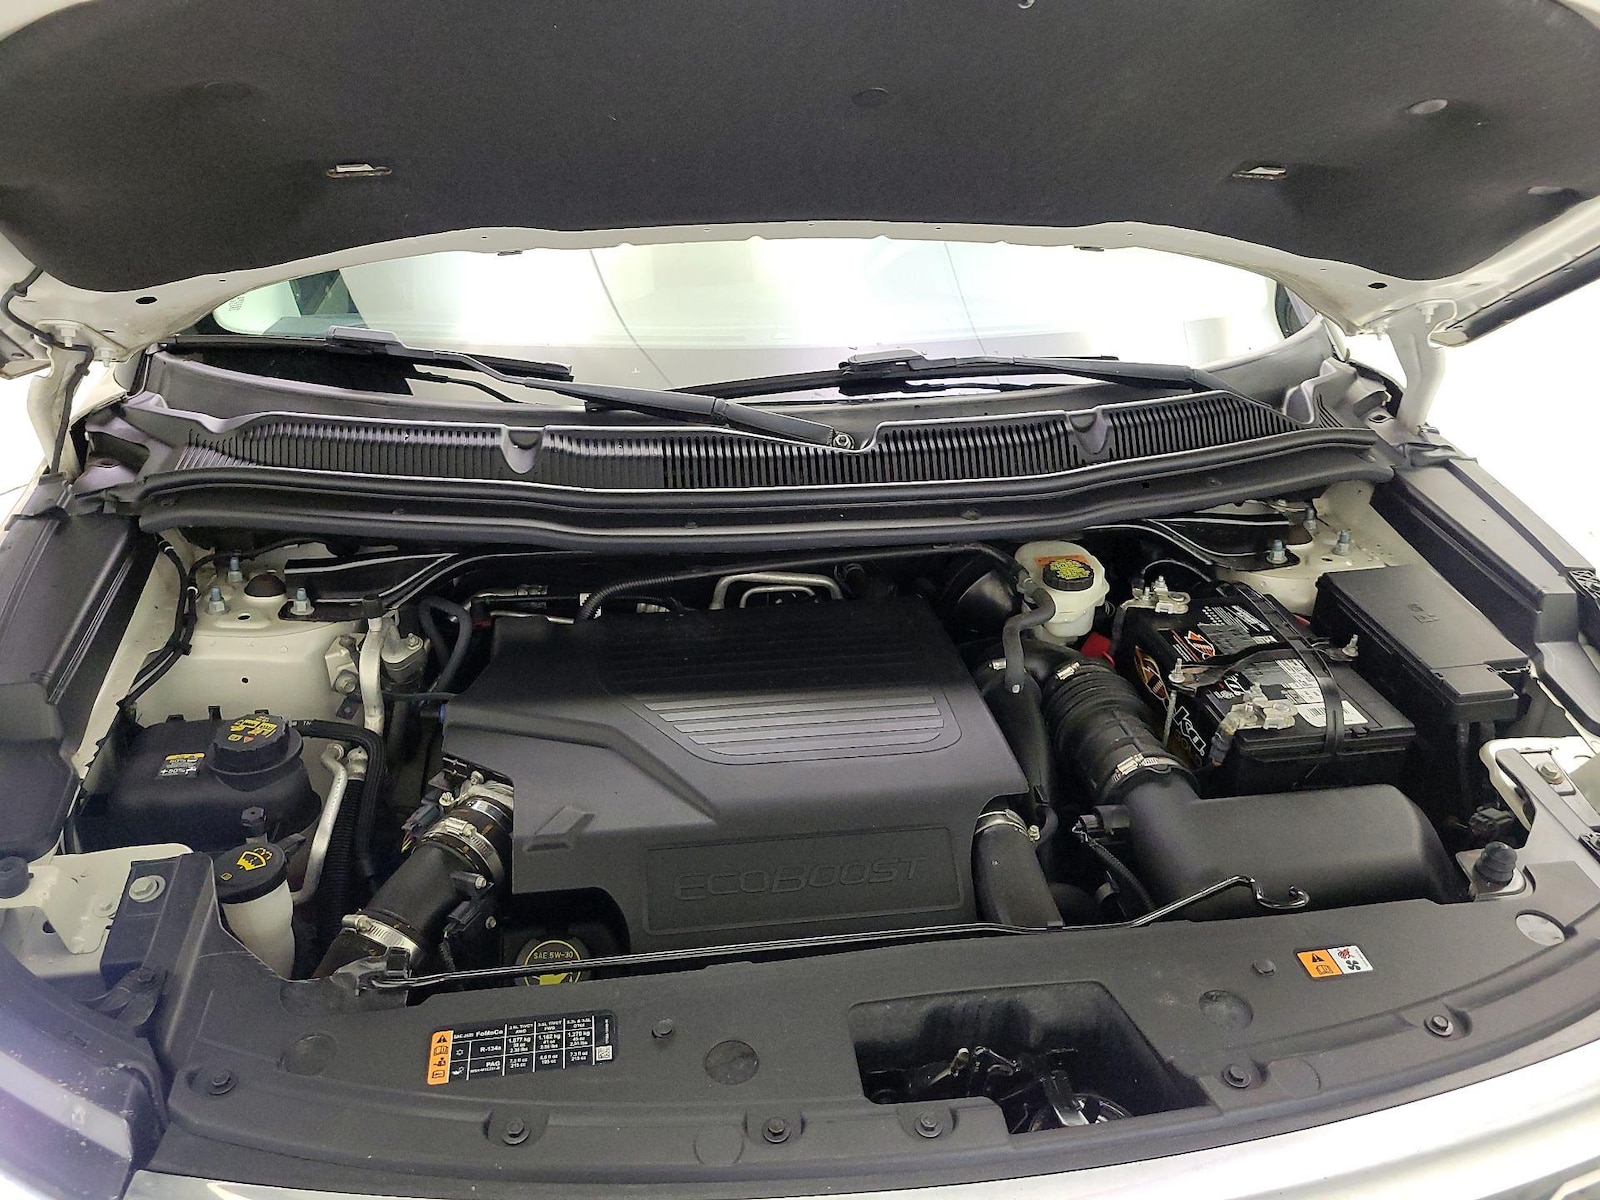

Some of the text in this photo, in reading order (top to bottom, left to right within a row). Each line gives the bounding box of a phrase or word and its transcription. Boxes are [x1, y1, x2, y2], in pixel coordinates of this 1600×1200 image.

[674, 855, 926, 900] ECOBOOST
[534, 951, 573, 959] SAE 5W-30
